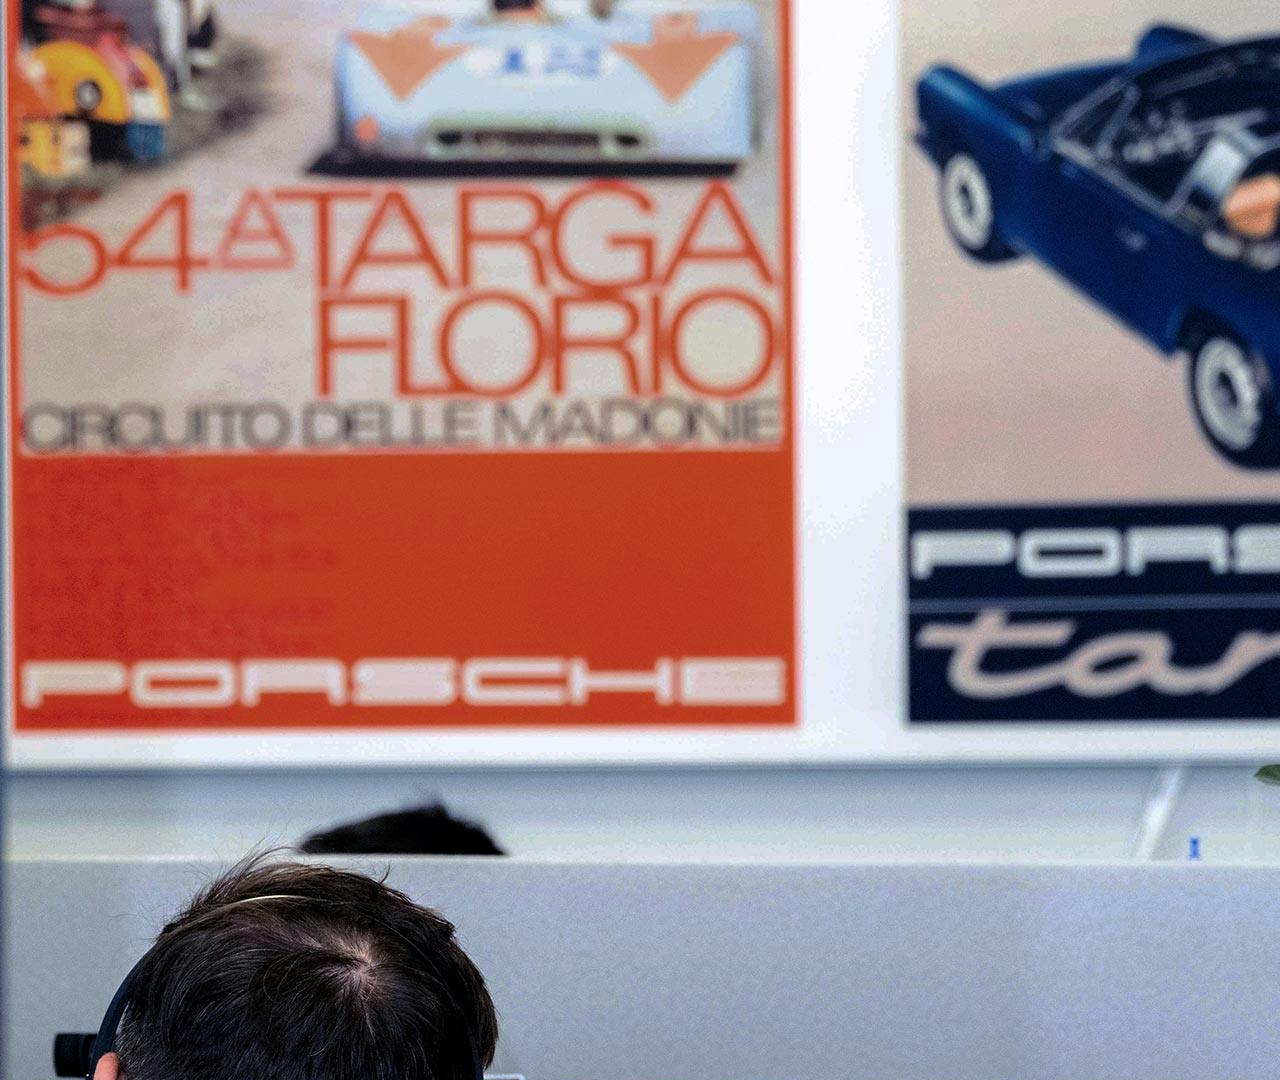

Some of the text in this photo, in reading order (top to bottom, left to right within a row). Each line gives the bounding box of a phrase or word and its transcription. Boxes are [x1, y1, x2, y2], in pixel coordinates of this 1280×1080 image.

[272, 179, 776, 291] TARGA
[315, 289, 777, 398] FLORIO
[21, 398, 781, 452] CIRCUITO DELLE MADONIE
[21, 656, 788, 709] PORSCHE
